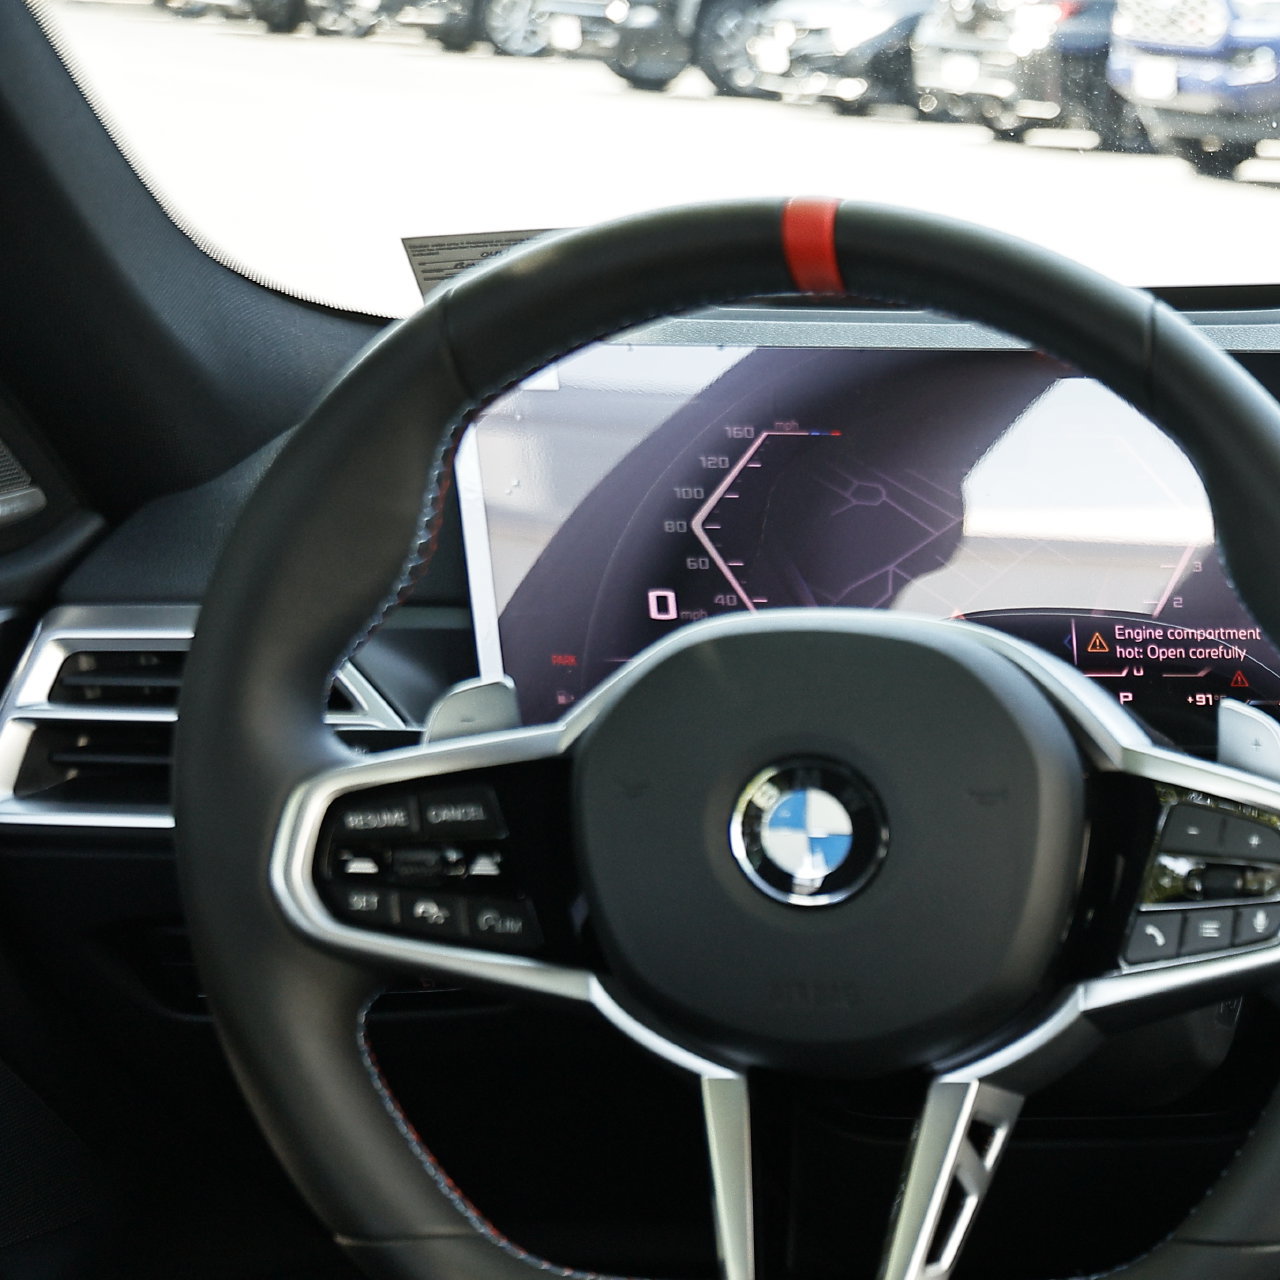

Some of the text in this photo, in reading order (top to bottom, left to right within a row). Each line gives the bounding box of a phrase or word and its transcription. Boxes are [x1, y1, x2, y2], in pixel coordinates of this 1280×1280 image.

[724, 426, 755, 439] 160
[774, 420, 799, 432] mph
[698, 457, 729, 469] 120
[674, 487, 704, 499] 100
[664, 520, 688, 533] 80
[686, 557, 710, 570] 60
[648, 589, 678, 620] 0
[714, 595, 737, 606] 40
[1173, 596, 1183, 609] 2
[1115, 625, 1261, 641] Engine compartment
[1116, 645, 1246, 662] hot: Open carefully
[1119, 693, 1133, 705] P
